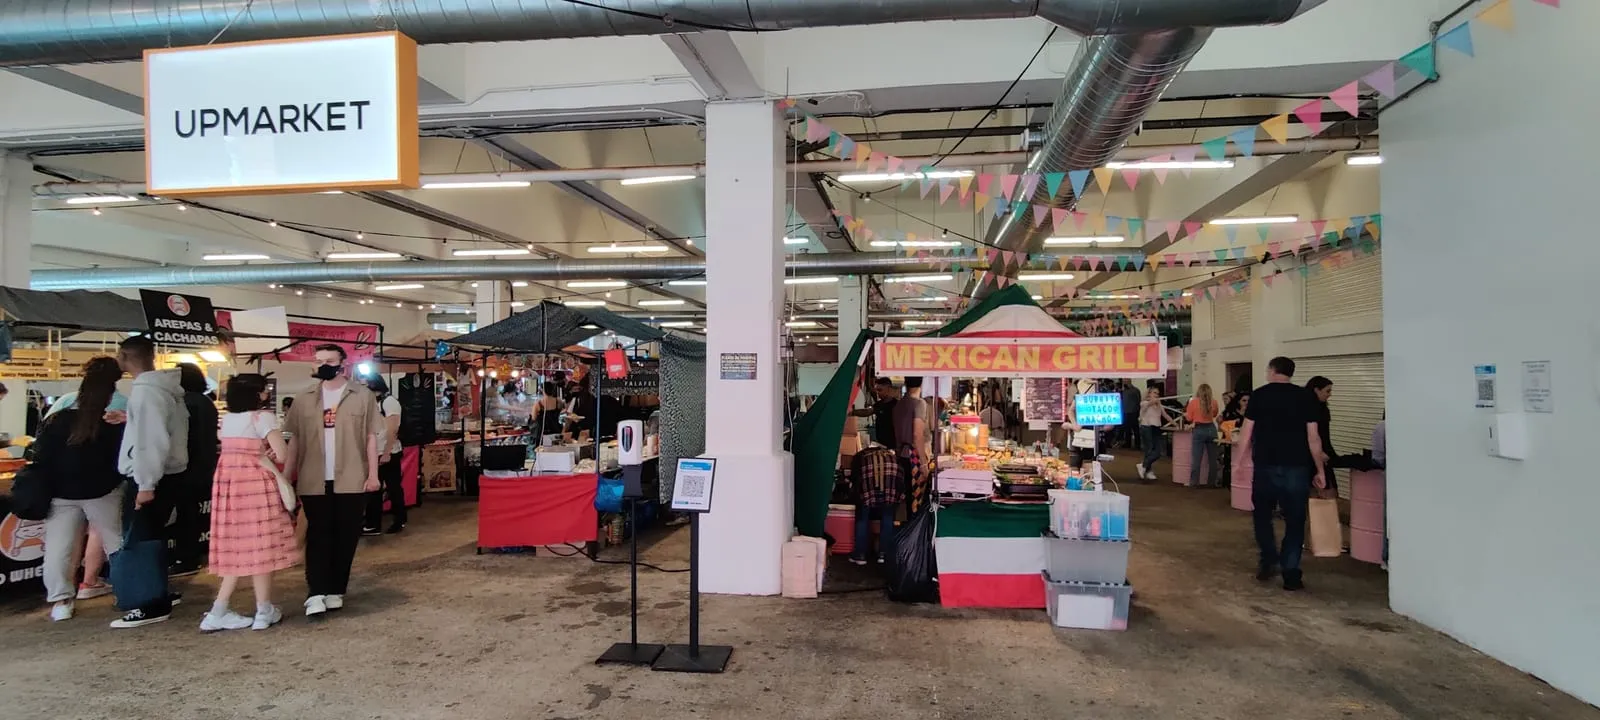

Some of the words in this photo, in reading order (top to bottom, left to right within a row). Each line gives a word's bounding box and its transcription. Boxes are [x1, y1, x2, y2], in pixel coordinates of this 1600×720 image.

[174, 100, 371, 138] UPMARKET
[154, 318, 203, 332] AREPAS
[204, 322, 214, 332] &
[153, 331, 220, 345] CACHAPAS
[885, 343, 1040, 370] MEXICAN
[1052, 344, 1157, 370] GRILL
[1092, 404, 1113, 413] TACO
[10, 565, 44, 583] WHE
